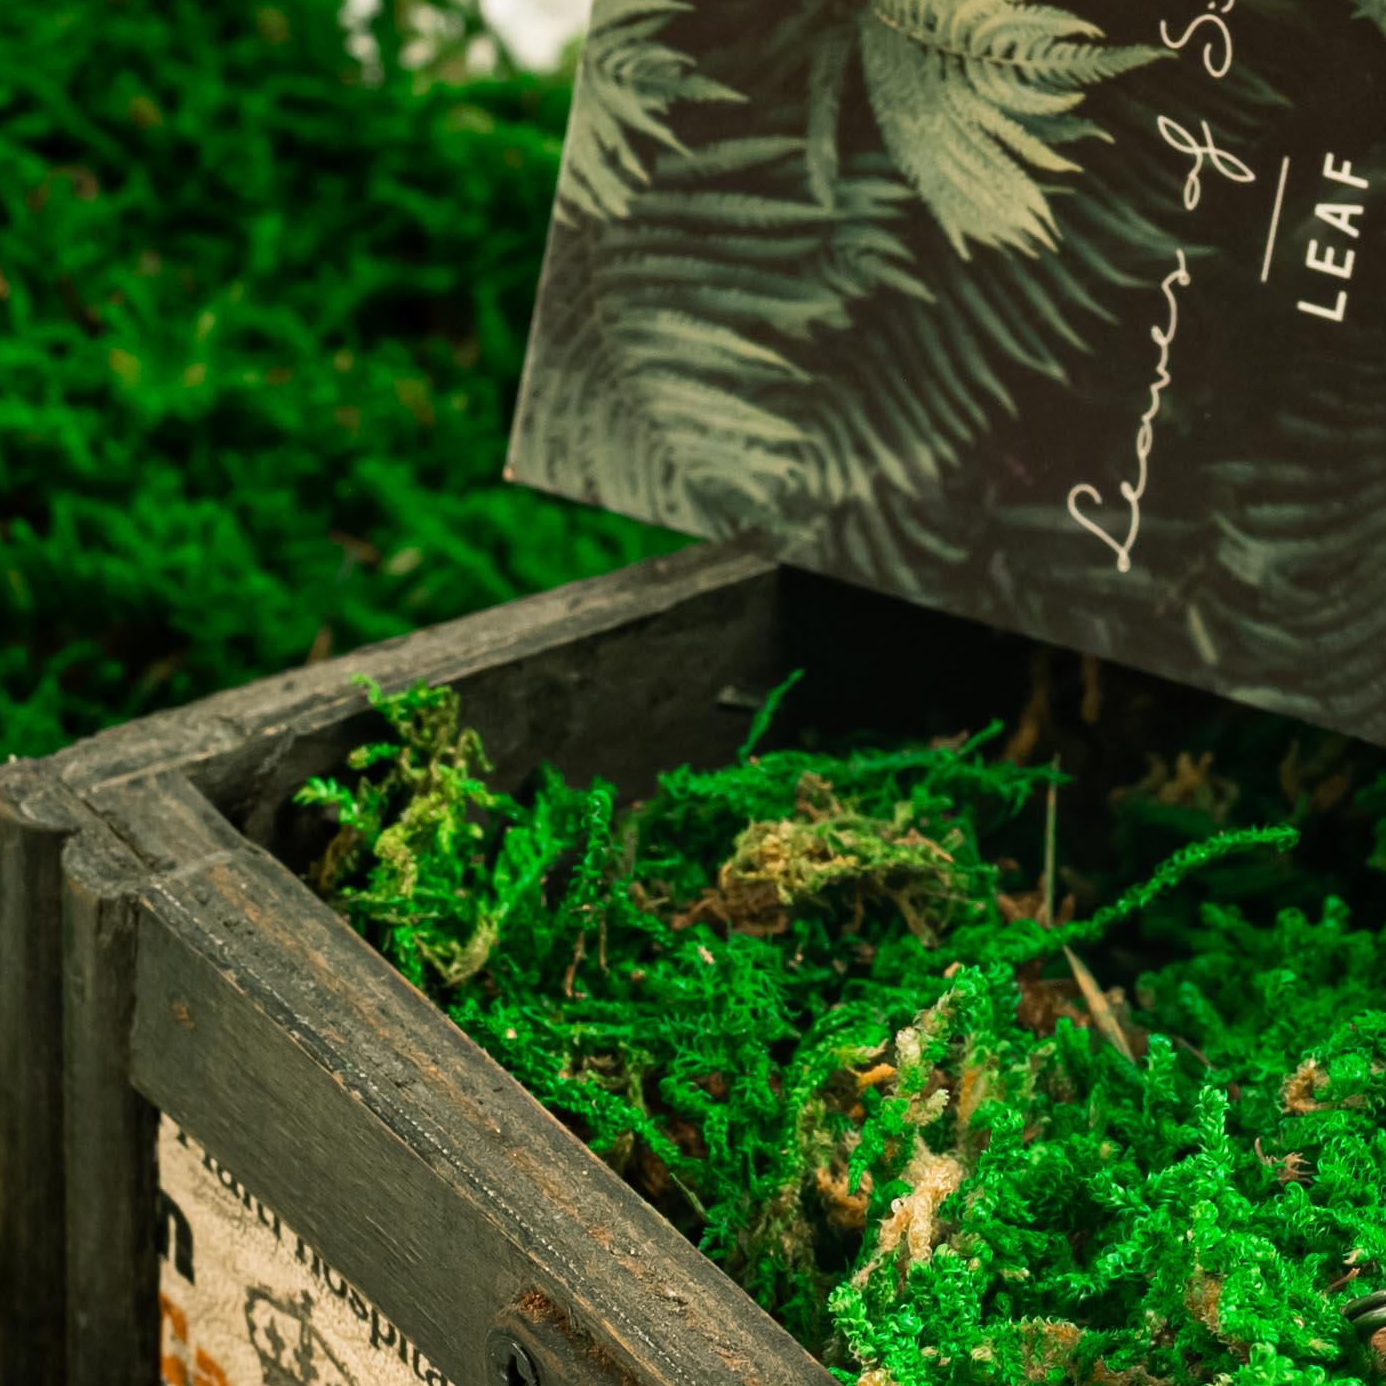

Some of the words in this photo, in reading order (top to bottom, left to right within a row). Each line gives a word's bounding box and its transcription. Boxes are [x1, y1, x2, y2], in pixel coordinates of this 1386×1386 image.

[1068, 249, 1191, 573] Leaves
[1157, 115, 1255, 210] of
[1296, 151, 1370, 322] LEAF
